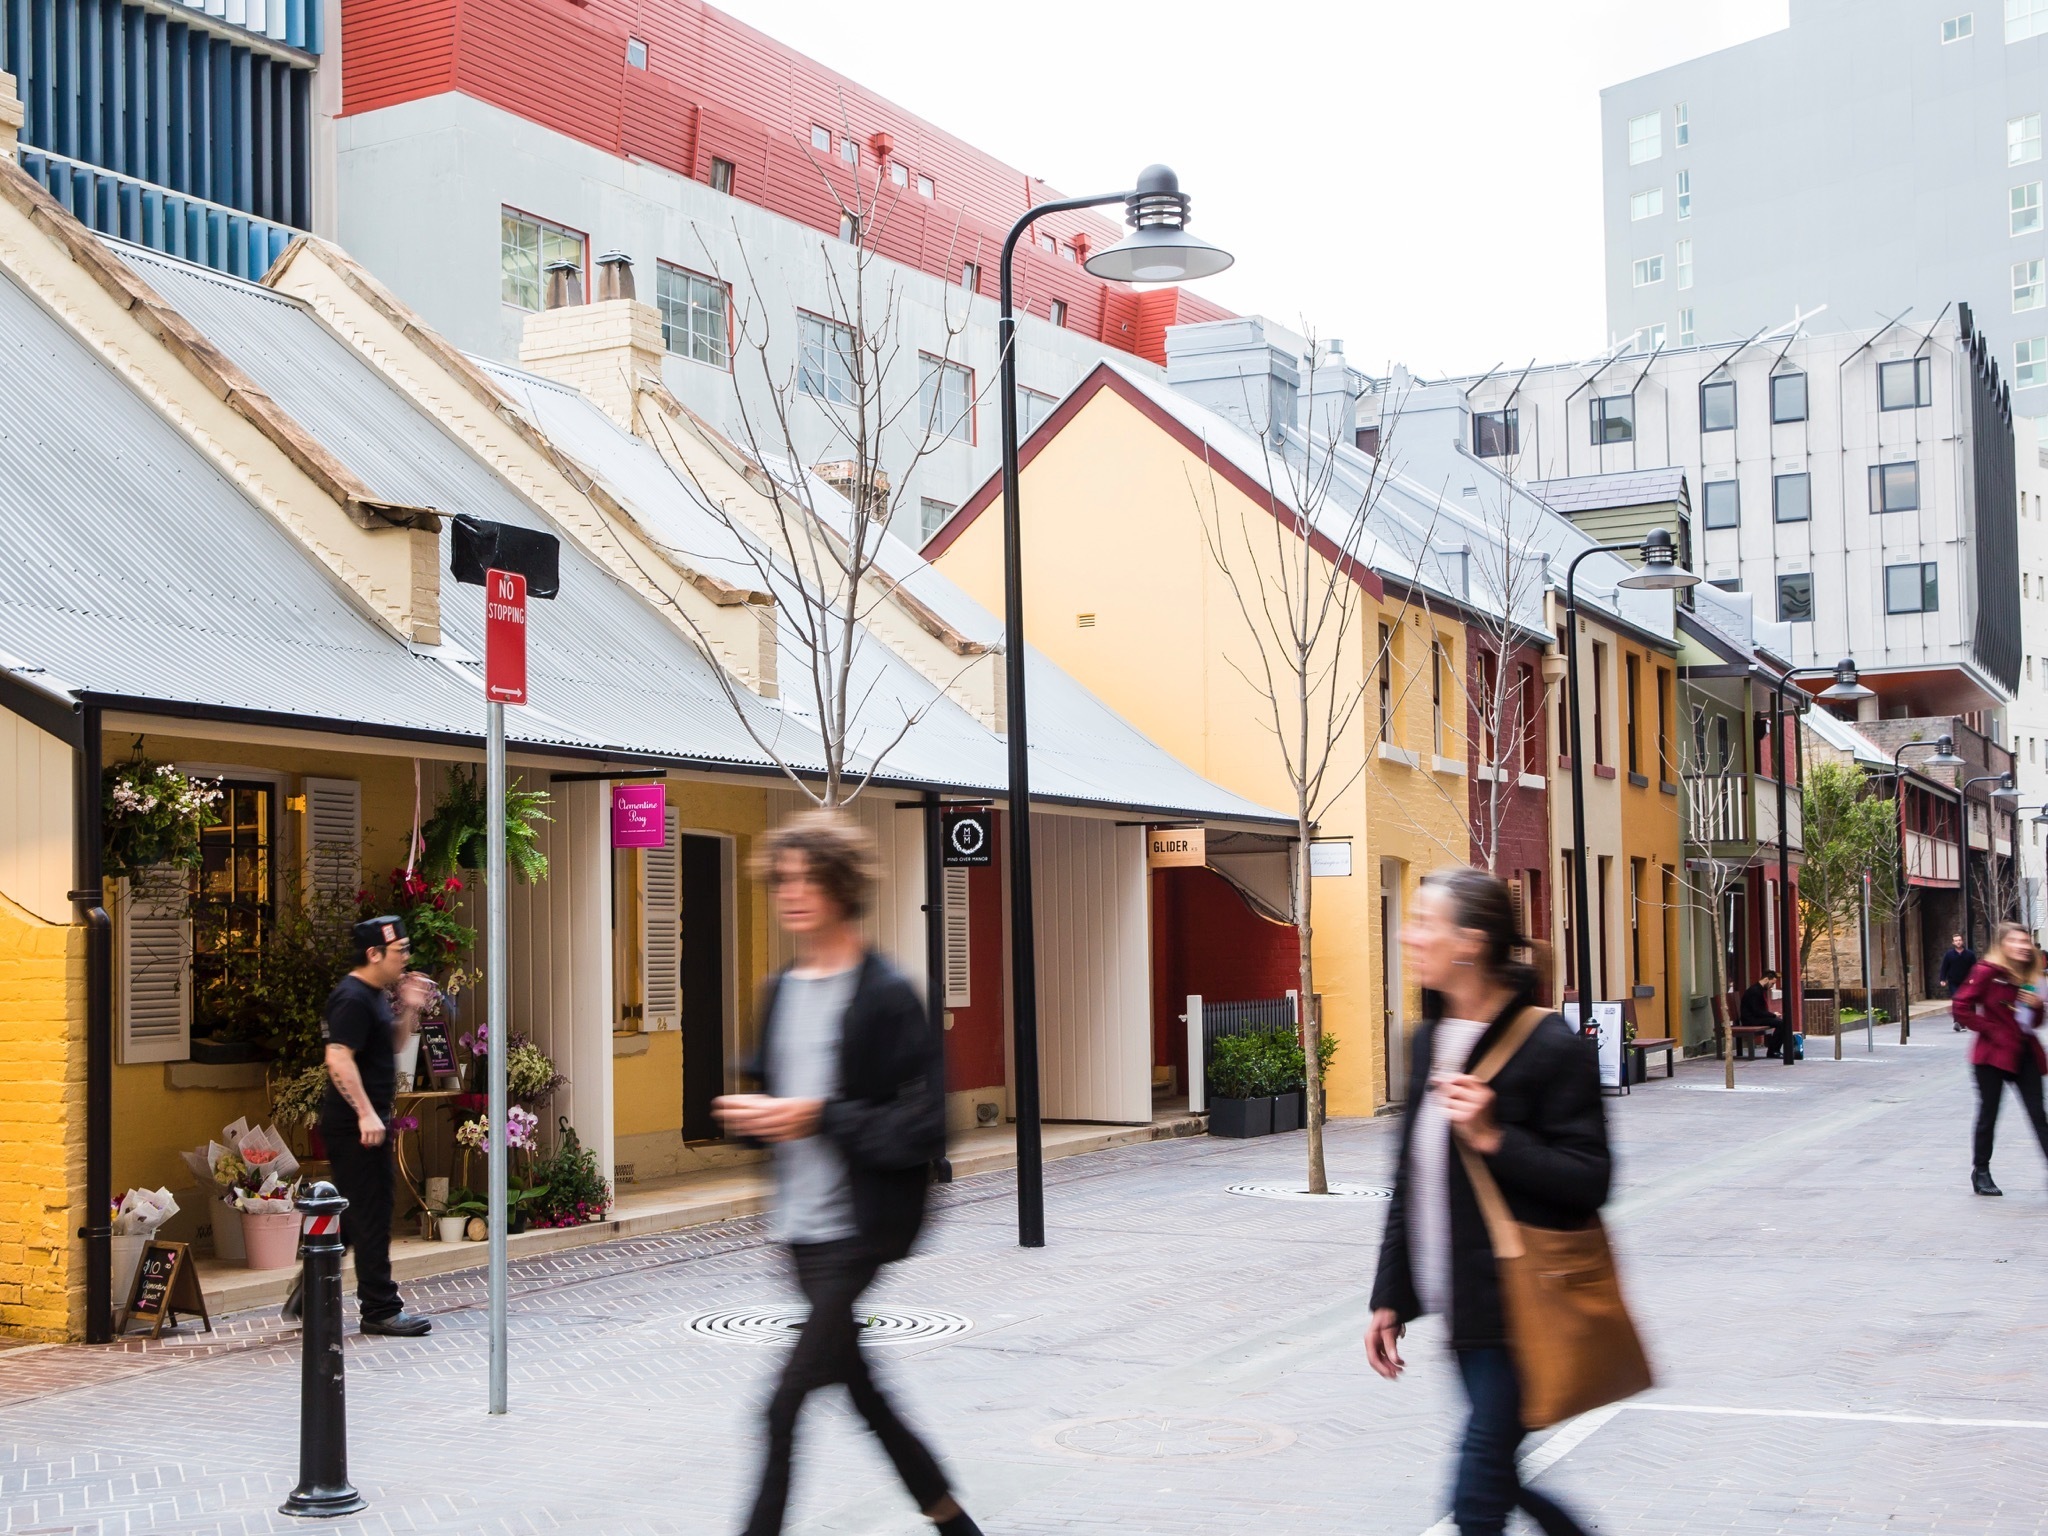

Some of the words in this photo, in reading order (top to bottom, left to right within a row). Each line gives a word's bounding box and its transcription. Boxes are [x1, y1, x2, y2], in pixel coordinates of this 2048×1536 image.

[499, 579, 514, 600] NO
[488, 603, 525, 624] STOPPING
[618, 797, 658, 810] Clementine
[628, 810, 647, 827] Posy
[1153, 840, 1188, 853] GLIDER
[143, 1259, 161, 1275] $10
